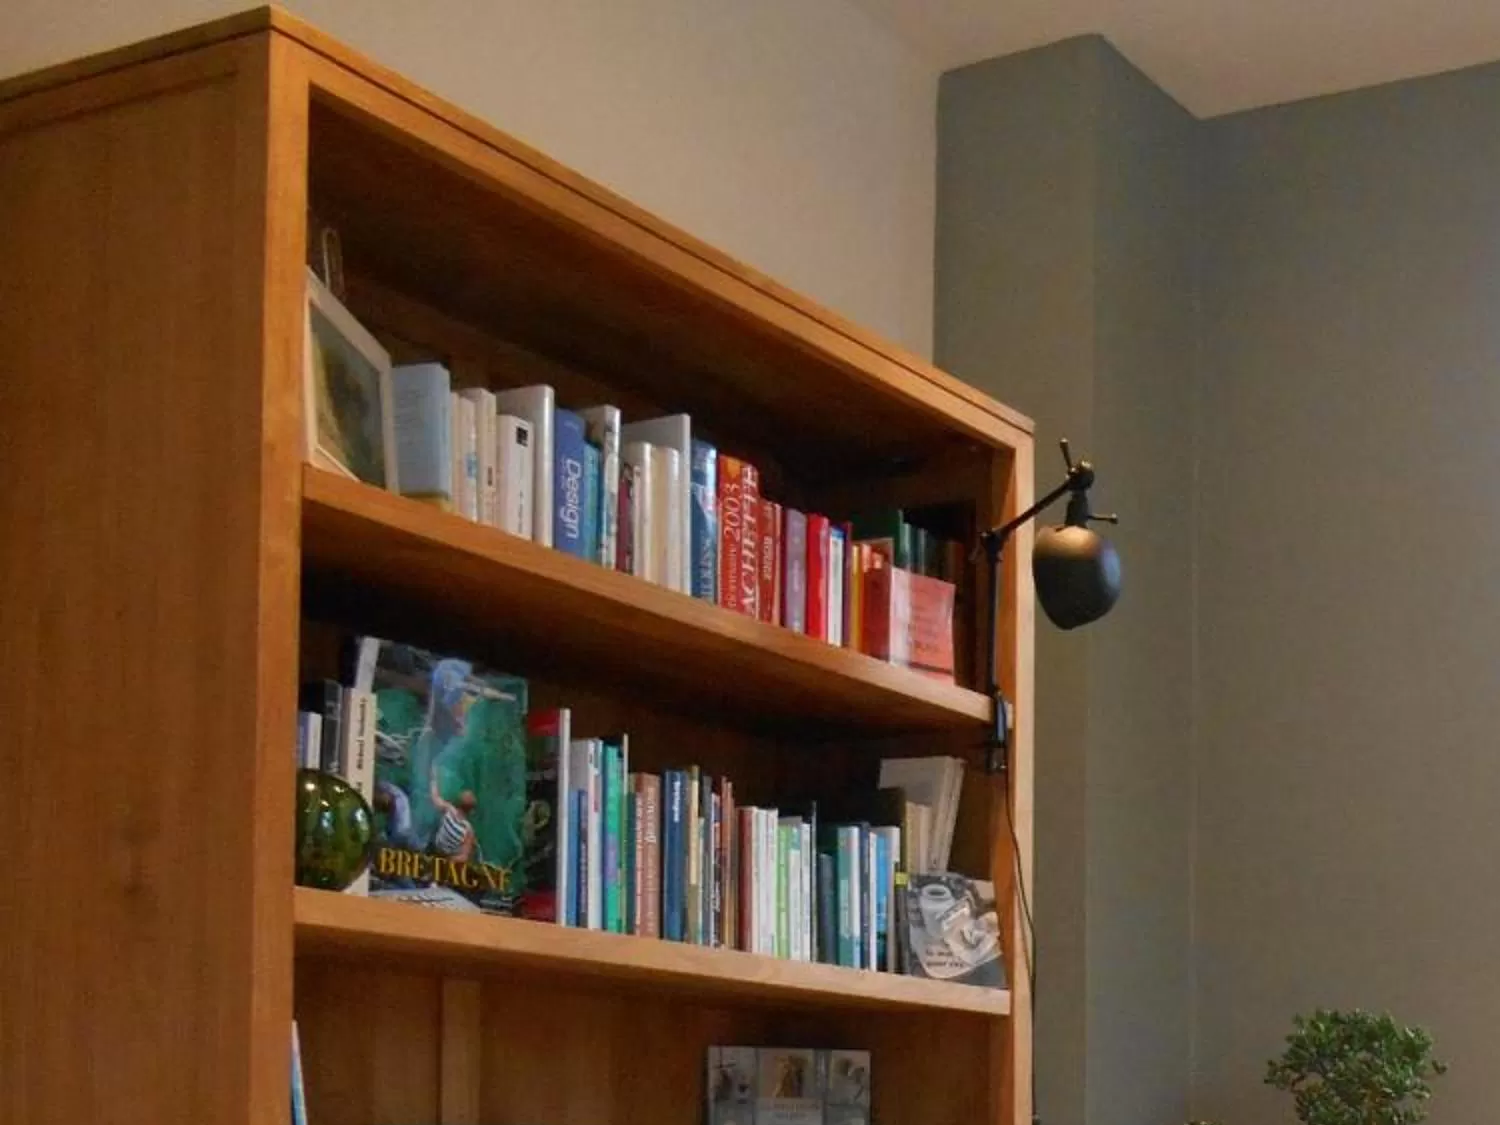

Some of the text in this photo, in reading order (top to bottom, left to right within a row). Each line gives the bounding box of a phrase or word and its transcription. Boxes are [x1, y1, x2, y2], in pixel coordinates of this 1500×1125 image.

[559, 456, 583, 541] Design
[723, 482, 741, 544] 2003
[740, 464, 759, 616] ACHETTE
[378, 846, 513, 894] BRETAGNE
